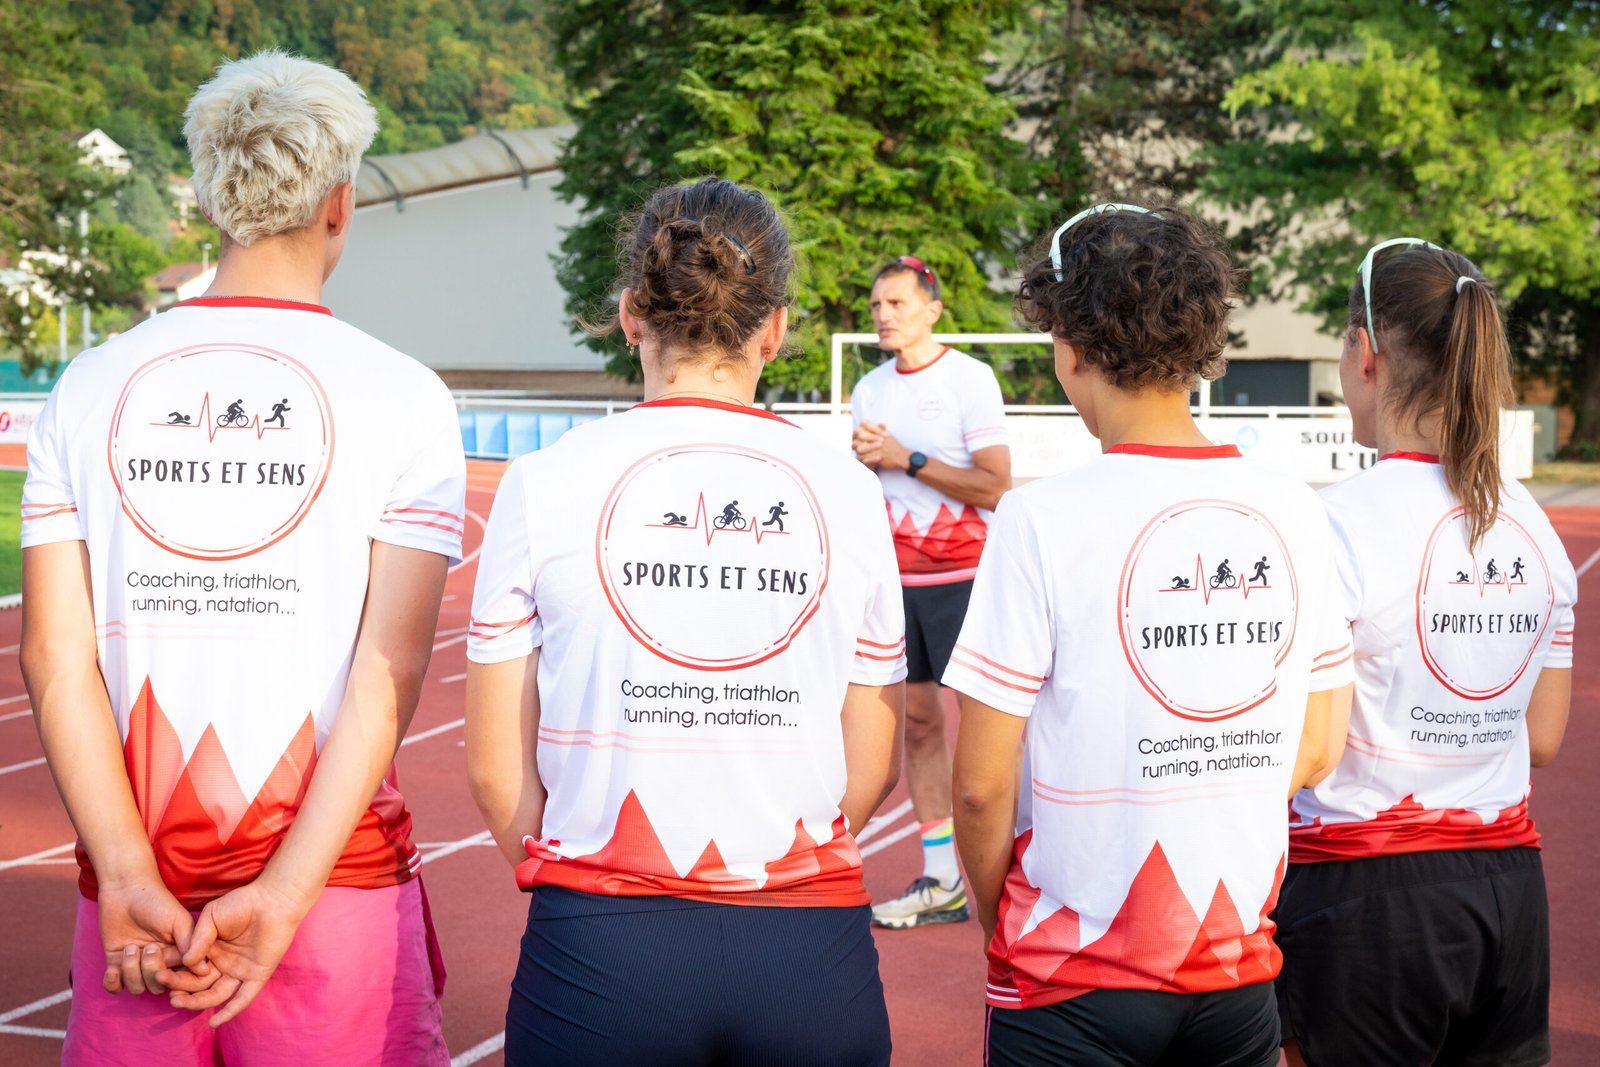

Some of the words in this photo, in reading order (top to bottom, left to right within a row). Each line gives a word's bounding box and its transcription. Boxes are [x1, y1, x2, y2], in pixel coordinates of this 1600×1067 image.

[128, 458, 210, 483] SPORTS
[221, 461, 247, 484] ET
[256, 462, 306, 486] SENS
[127, 571, 219, 592] Coaching,
[223, 573, 301, 593] triathlon,
[623, 562, 709, 589] SPORTS
[720, 566, 747, 590] ET
[757, 568, 808, 596] SENS
[132, 596, 202, 616] running,
[206, 597, 296, 615] natation...
[1430, 613, 1483, 634] SPORTS
[1488, 614, 1504, 634] ET
[1508, 614, 1539, 634] SENS
[1142, 623, 1208, 650] SPORTS
[1216, 622, 1238, 645] ET
[621, 679, 719, 704] Coaching,
[624, 707, 700, 729] running,
[704, 708, 798, 728] natation...
[1410, 706, 1482, 728] Coaching,
[1138, 734, 1219, 755] Coaching,
[1411, 729, 1470, 748] running,
[1142, 759, 1202, 779] running,
[1207, 752, 1283, 771] natation...
